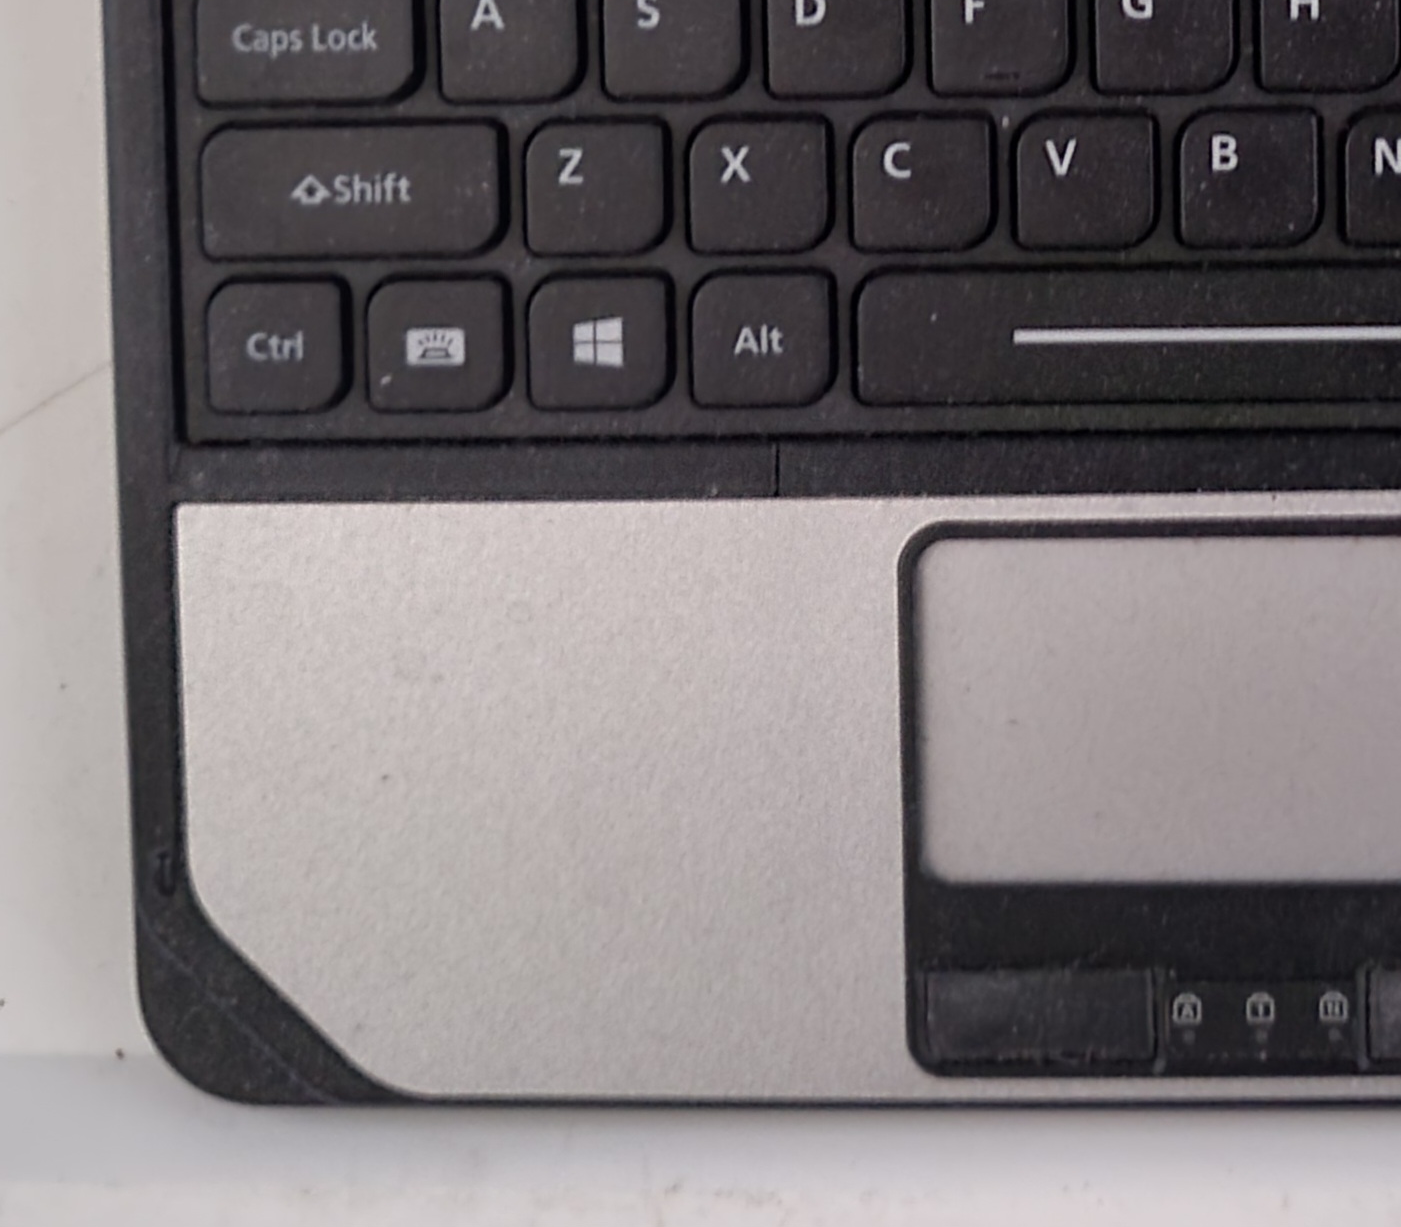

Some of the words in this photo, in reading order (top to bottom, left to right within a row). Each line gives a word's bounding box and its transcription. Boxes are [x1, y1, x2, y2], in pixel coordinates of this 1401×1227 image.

[232, 24, 303, 58] Caps
[312, 22, 377, 51] Lock
[559, 149, 583, 184] Z
[722, 147, 749, 182] X
[884, 143, 911, 178] C
[1046, 140, 1076, 175] V
[1212, 135, 1237, 171] B
[334, 173, 410, 203] Shift
[247, 331, 303, 360] Ctrl
[735, 325, 782, 354] Alt
